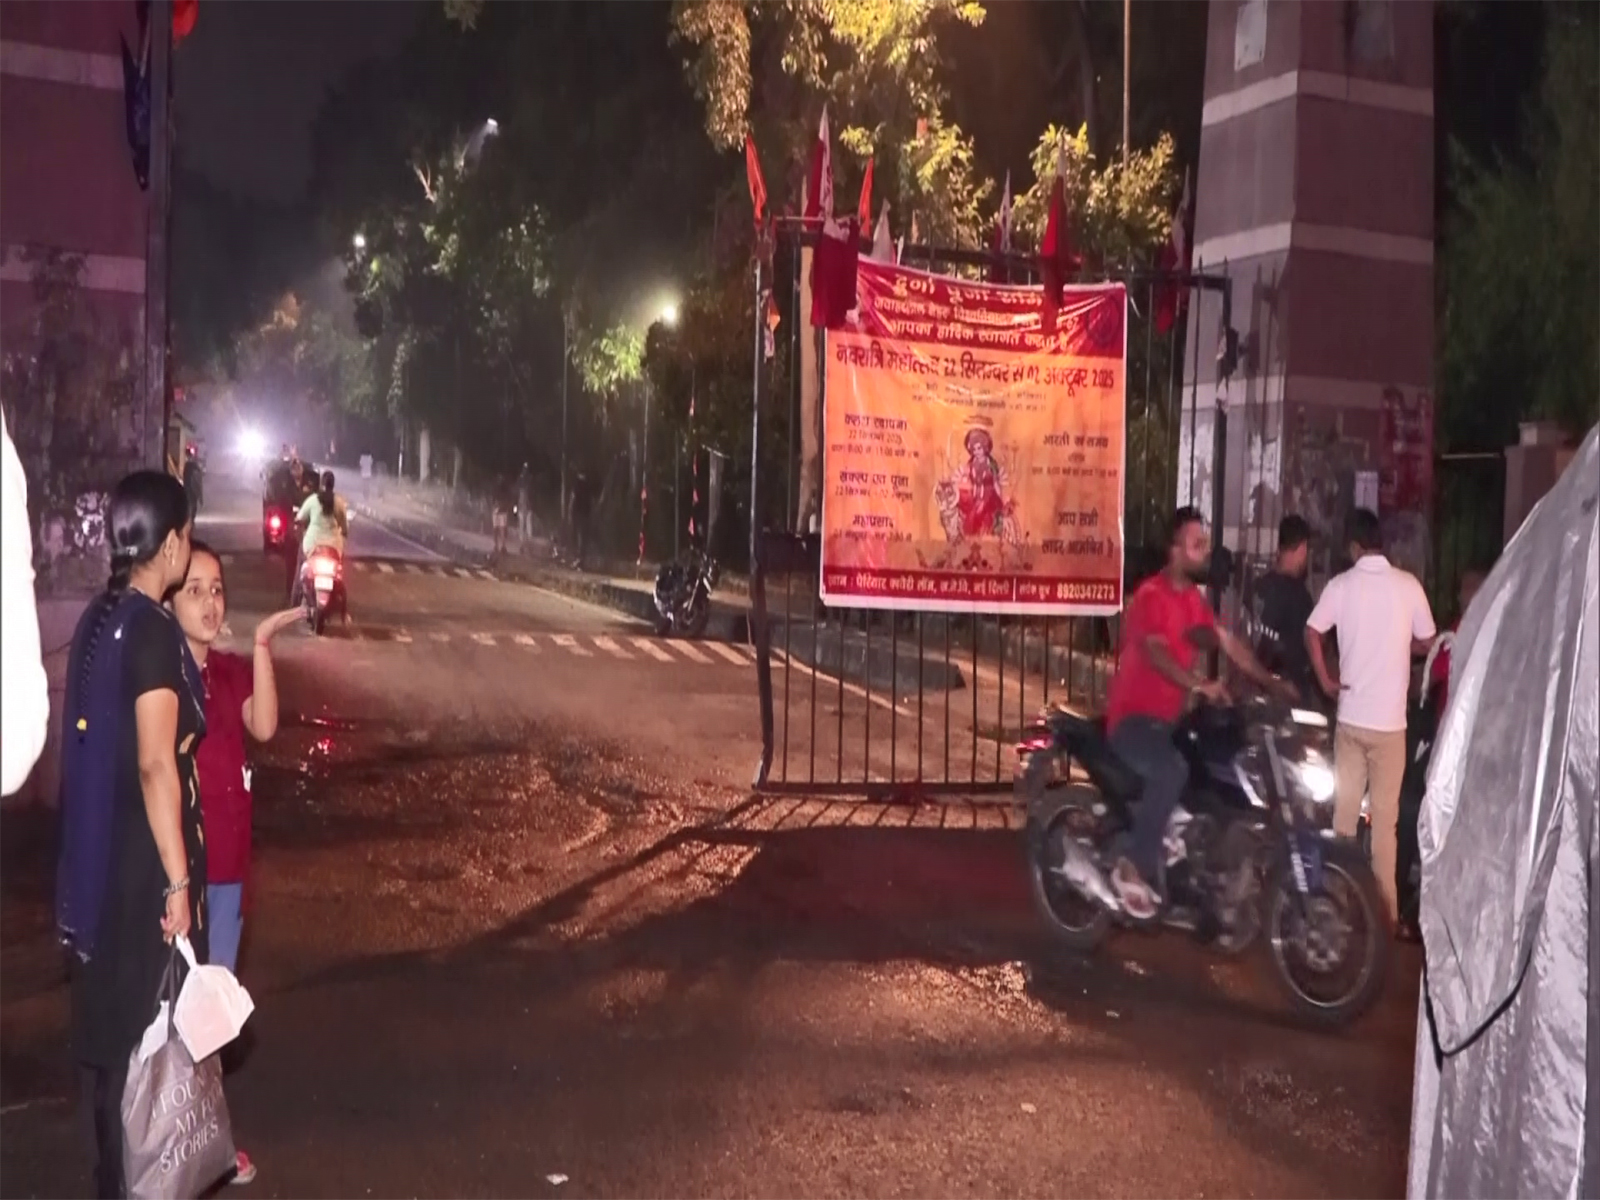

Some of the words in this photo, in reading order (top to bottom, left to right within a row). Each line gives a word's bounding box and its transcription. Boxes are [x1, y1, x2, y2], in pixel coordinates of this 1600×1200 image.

[836, 340, 884, 370] नवरात्रि
[887, 345, 940, 376] महोत्सव
[1092, 369, 1115, 389] 2025
[159, 1116, 219, 1173] STORIES
[175, 1105, 198, 1138] MY
